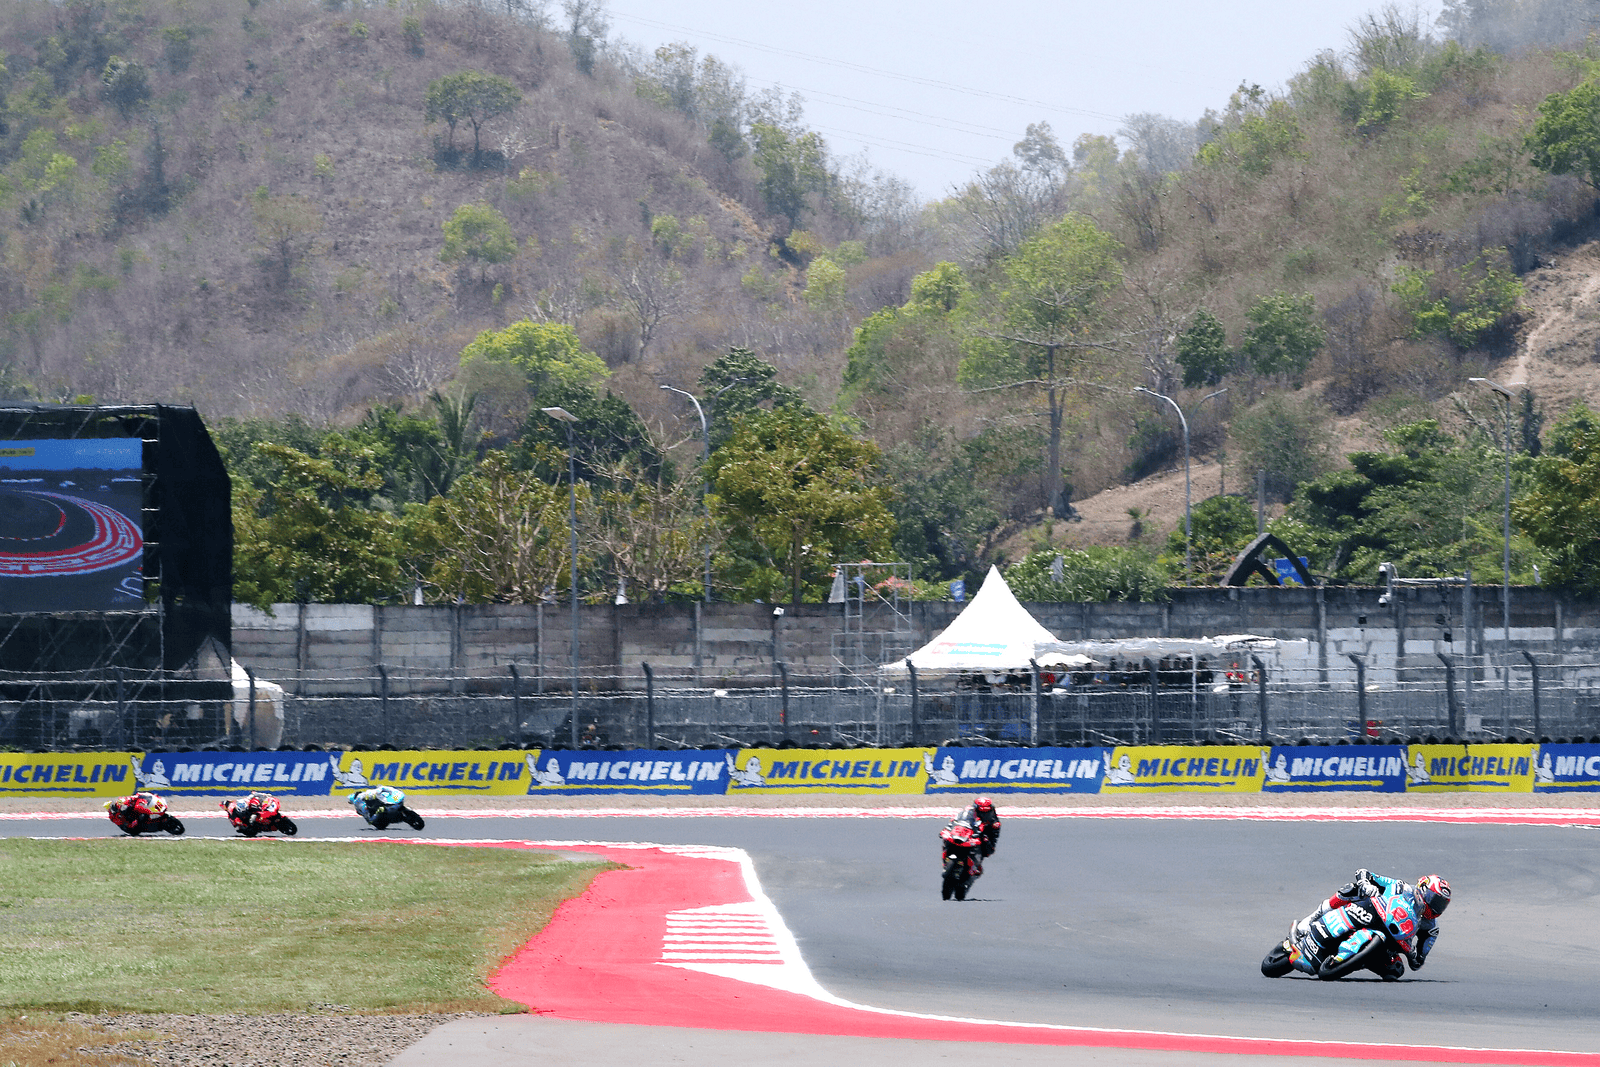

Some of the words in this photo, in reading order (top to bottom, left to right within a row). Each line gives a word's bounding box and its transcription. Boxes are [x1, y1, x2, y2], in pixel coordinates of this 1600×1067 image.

[0, 764, 128, 783] ICHELIN
[173, 763, 328, 782] MICHELIN
[371, 762, 524, 780] MICHELIN
[568, 761, 725, 781] MICHELIN
[769, 761, 920, 778] MICHELIN
[960, 759, 1100, 779] MICHELIN
[1137, 759, 1259, 776] MICHELIN
[1291, 757, 1402, 776] MICHELIN
[1431, 757, 1530, 775] MICHELIN
[1554, 756, 1600, 776] MIC
